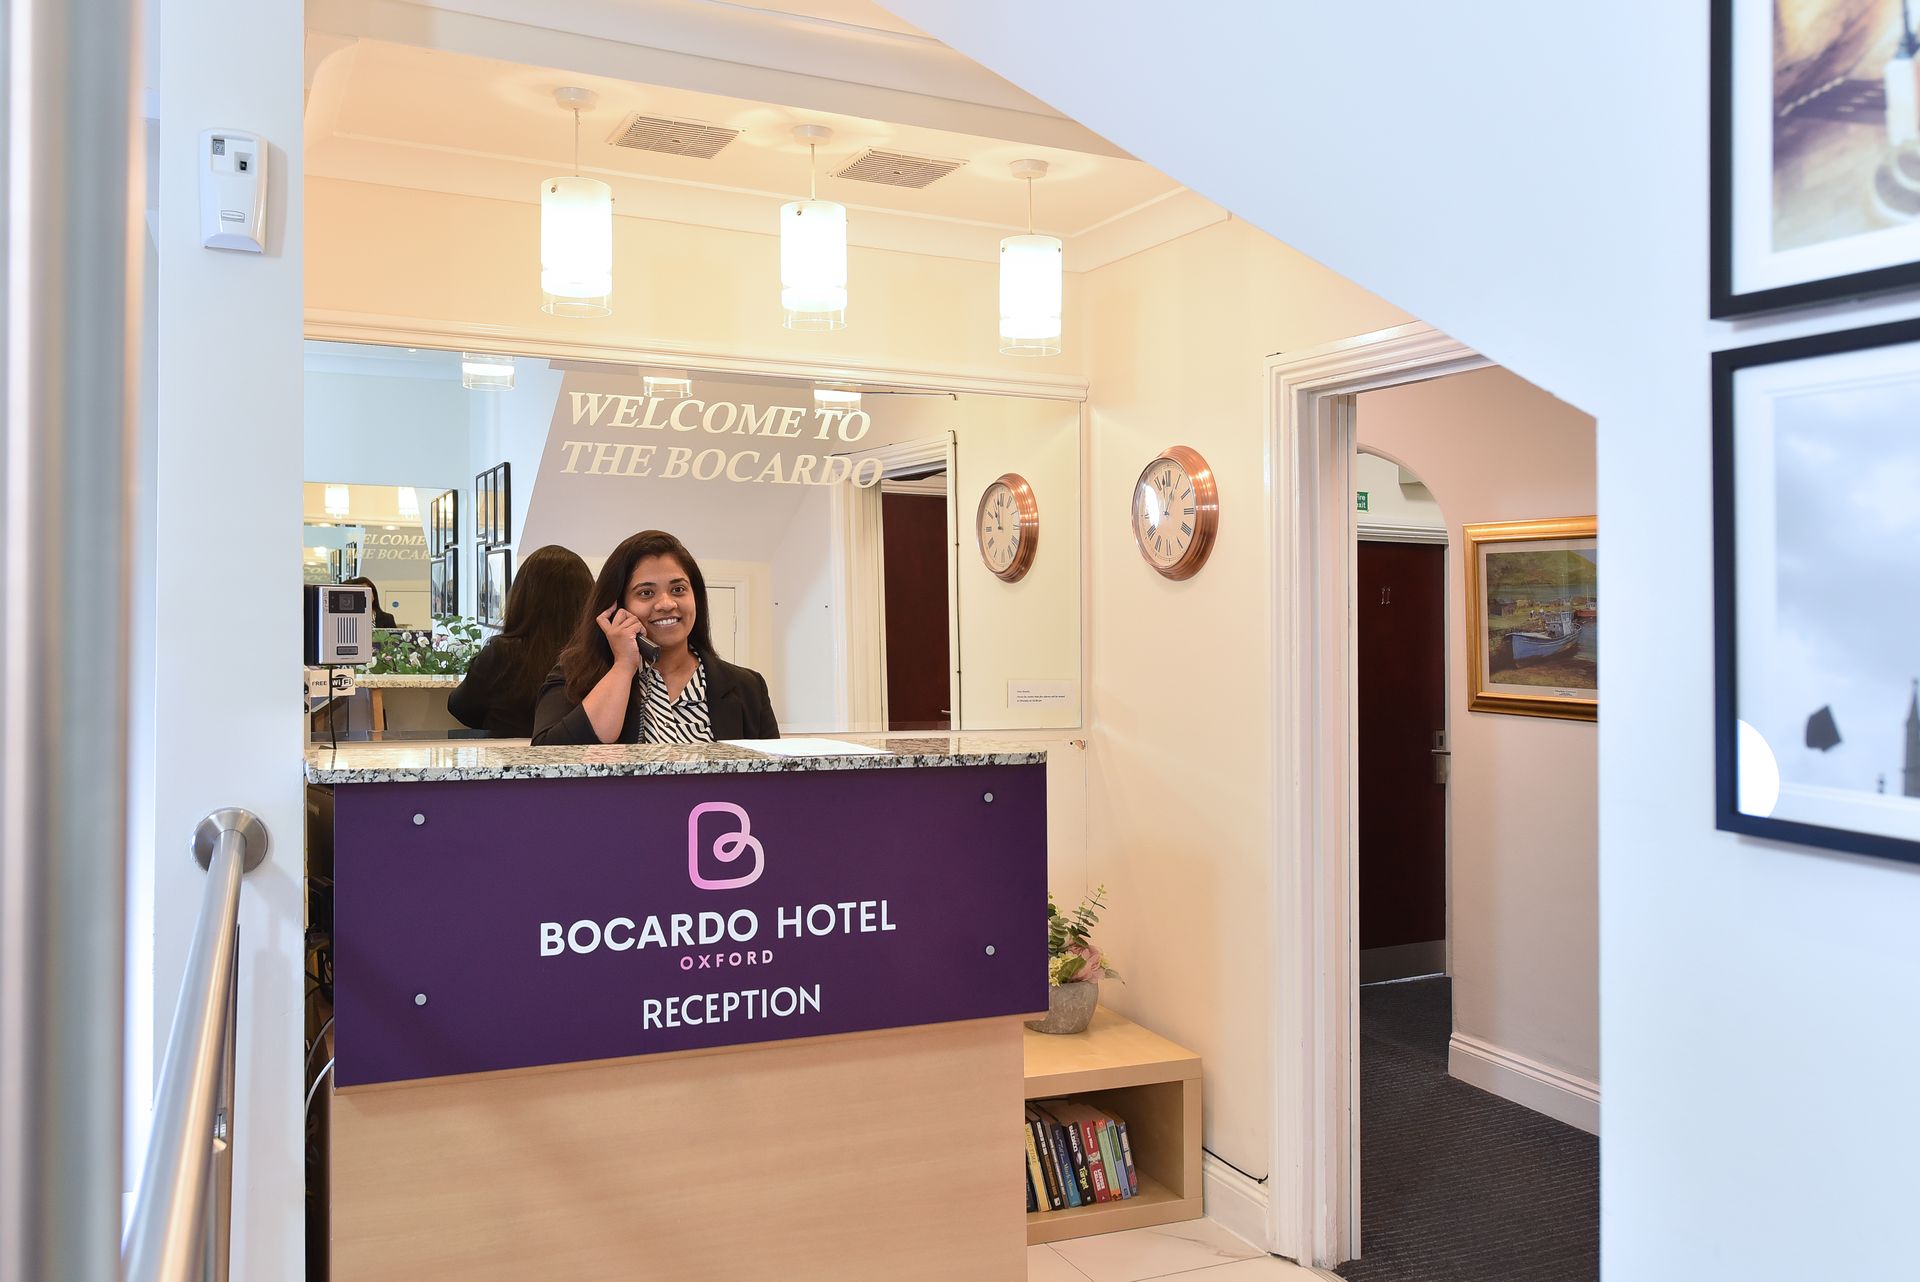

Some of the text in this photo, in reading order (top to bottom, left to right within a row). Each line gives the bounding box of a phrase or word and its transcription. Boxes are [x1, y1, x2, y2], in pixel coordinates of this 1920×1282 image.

[568, 391, 871, 442] WELCOME TO
[560, 440, 884, 489] THE BOCARDO
[363, 533, 427, 546] ELCOME
[377, 548, 432, 561] BOCAR
[540, 899, 897, 957] BOCARDO HOTEL
[679, 949, 774, 971] OXFORD
[643, 983, 822, 1030] RECEPTION
[1079, 1165, 1090, 1190] Target
